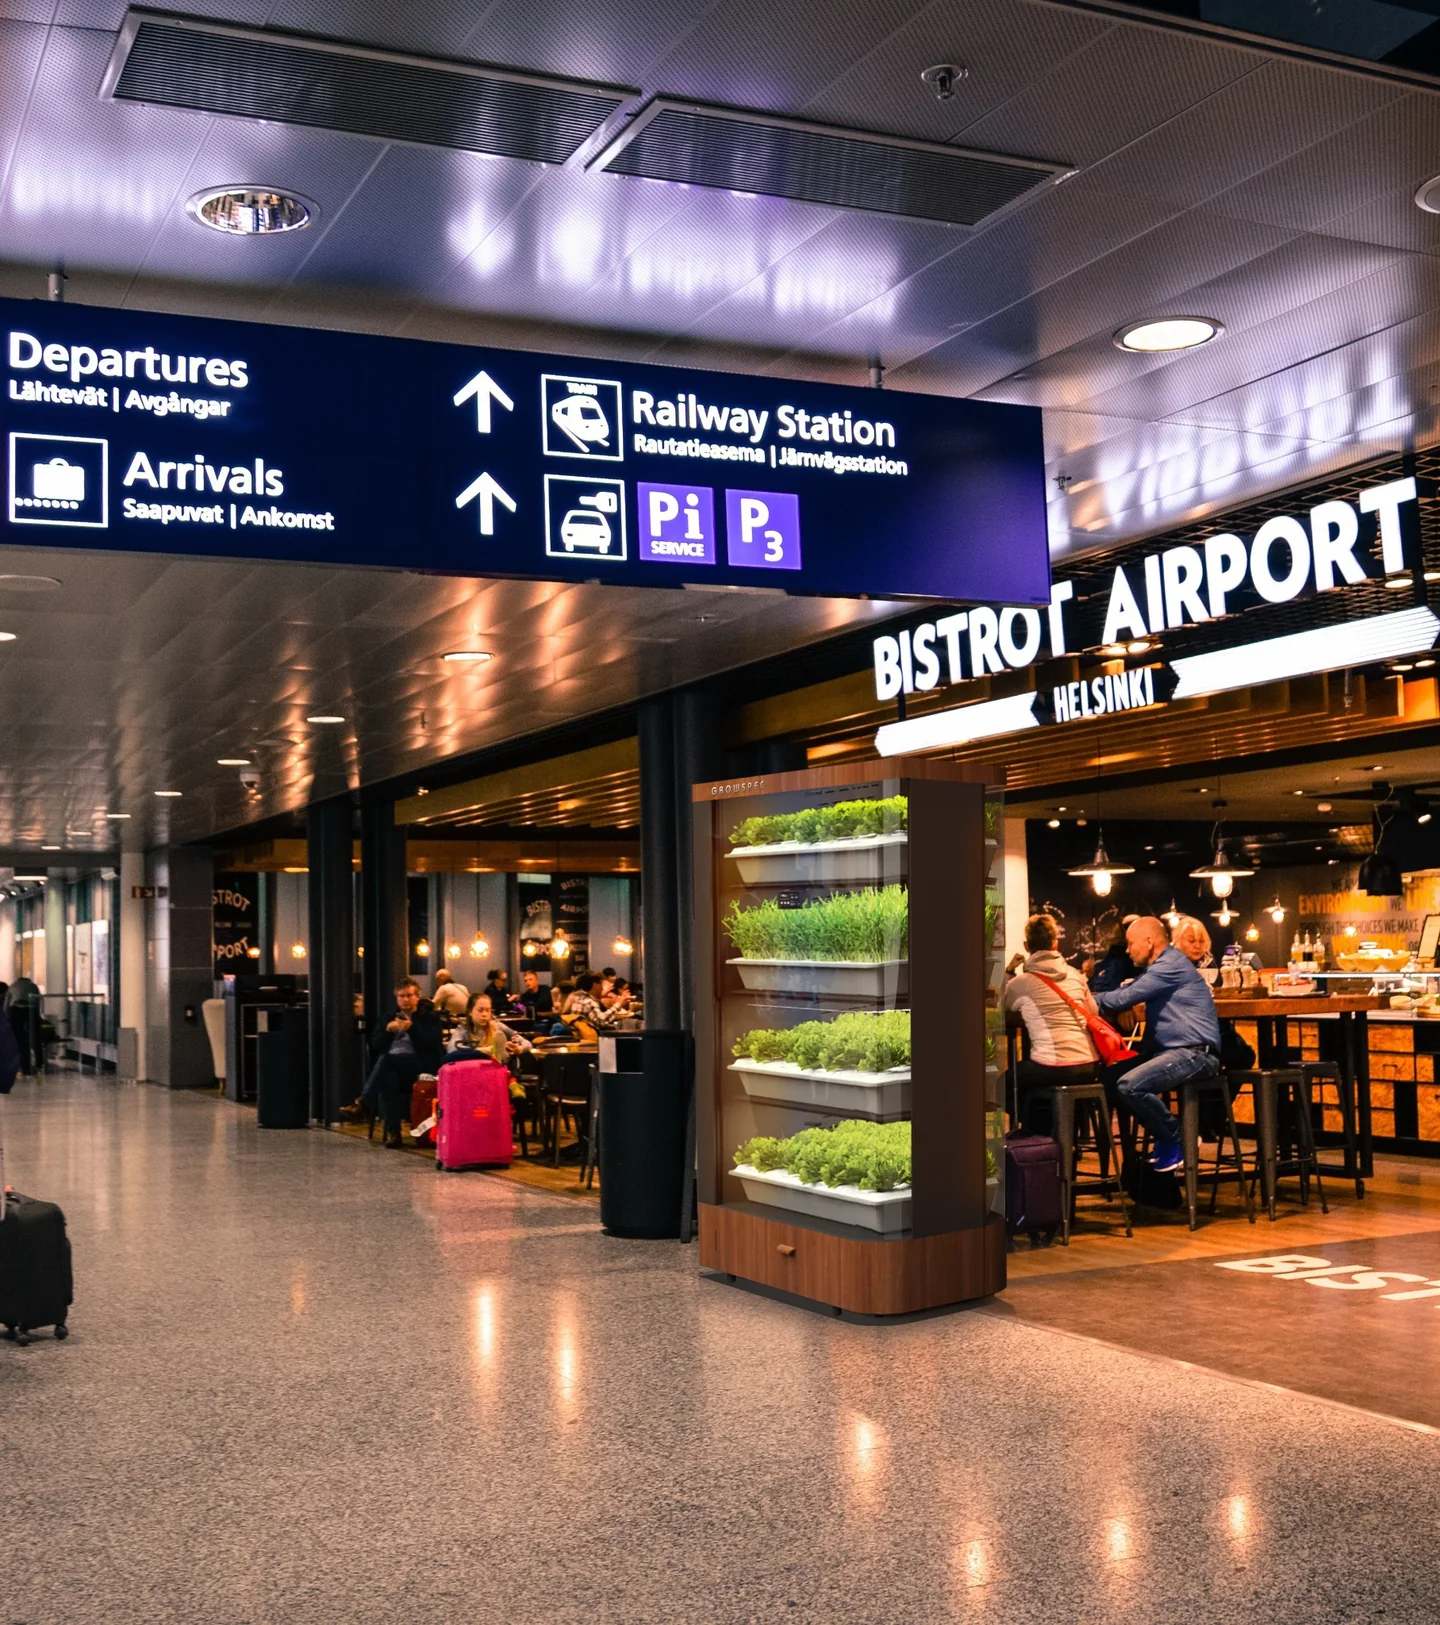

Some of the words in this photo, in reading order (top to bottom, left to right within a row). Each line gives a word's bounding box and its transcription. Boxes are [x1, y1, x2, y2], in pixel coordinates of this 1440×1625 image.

[9, 331, 249, 388] Departures
[9, 379, 108, 407] Lähtevät
[124, 389, 232, 420] Avgångar
[632, 390, 769, 444] Railway
[777, 405, 896, 448] Station
[123, 451, 284, 497] Arrivals
[633, 433, 766, 463] Rautatieasema
[778, 446, 909, 476] Järnvägsstation
[123, 497, 225, 525] Saapuvat
[240, 507, 336, 532] Ankomst
[650, 539, 705, 558] SERVICE
[873, 580, 1073, 701] BISTROT
[1102, 476, 1417, 646] AIRPORT
[1053, 667, 1154, 723] HELSINKI
[1384, 919, 1397, 934] WE
[1398, 918, 1419, 933] MAKE
